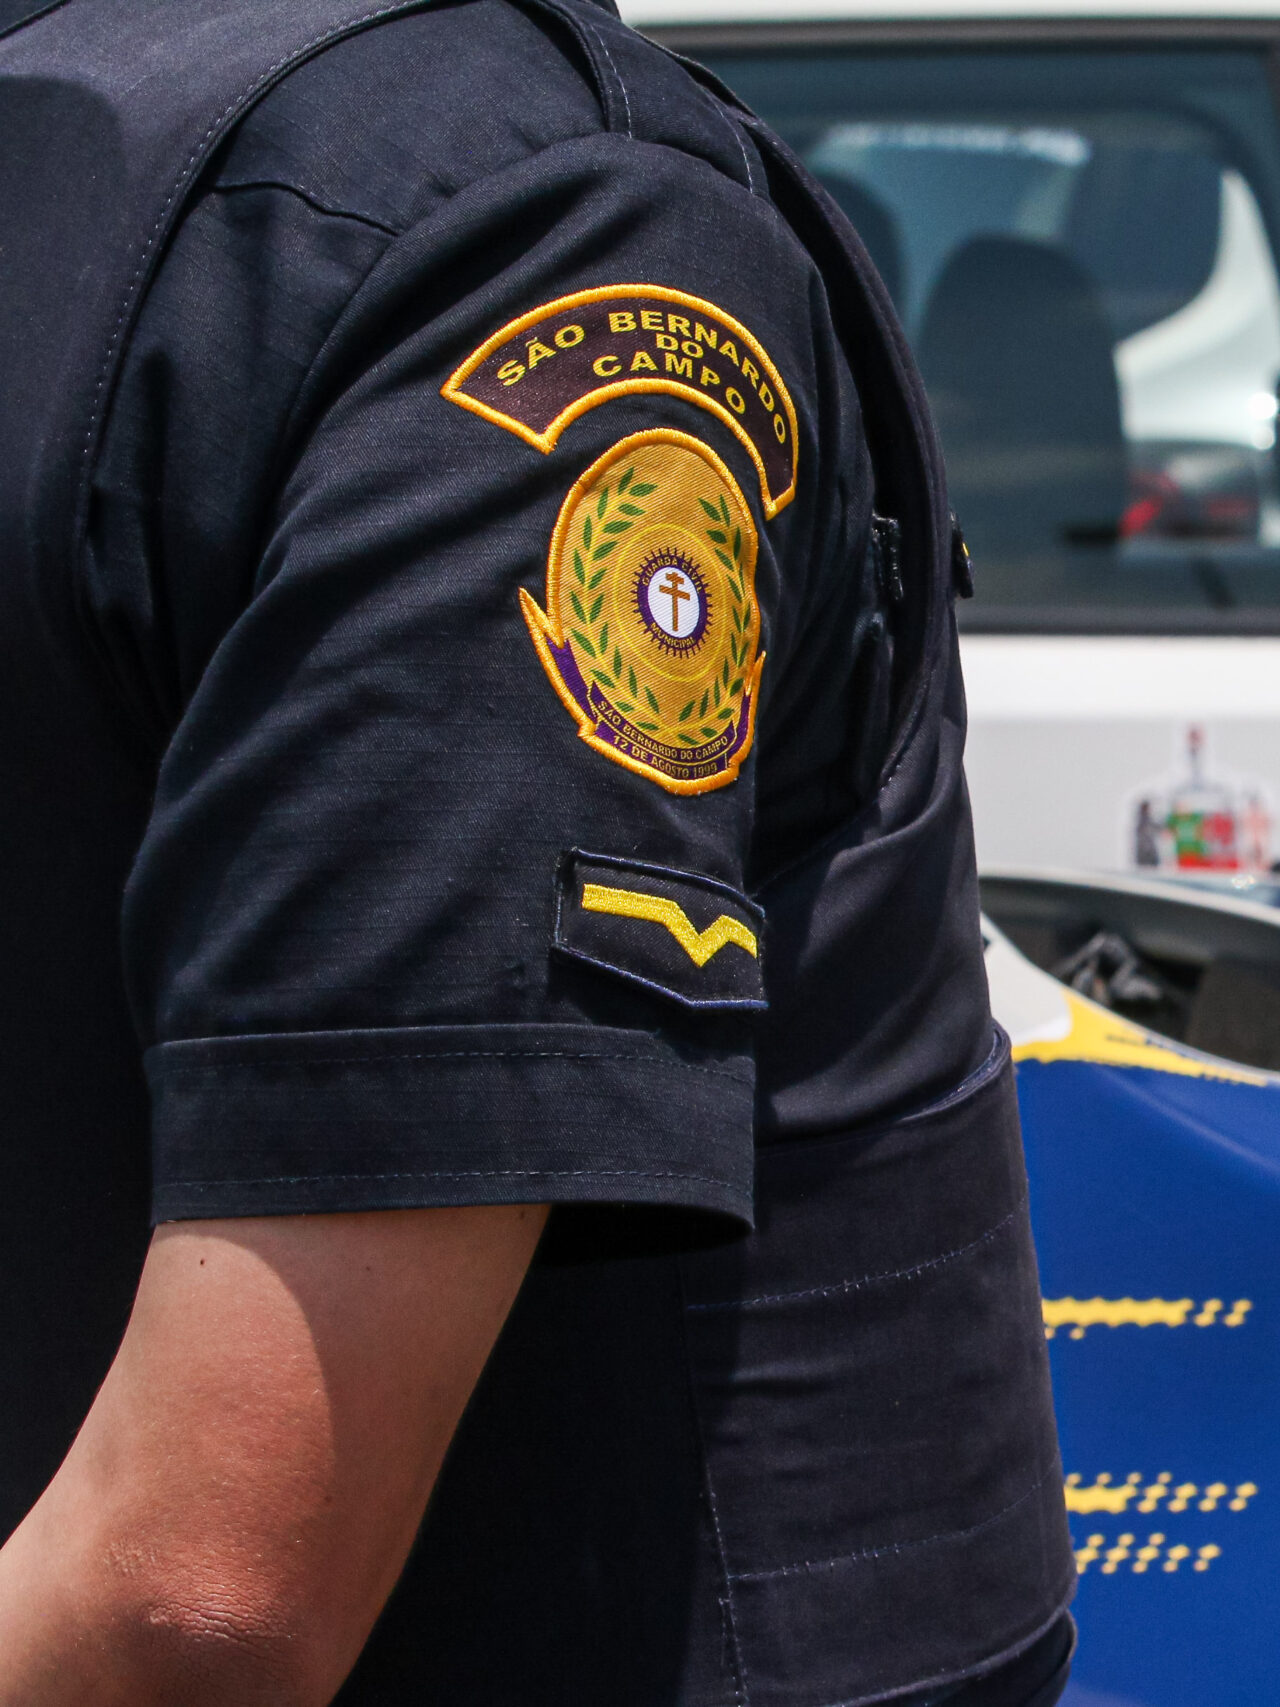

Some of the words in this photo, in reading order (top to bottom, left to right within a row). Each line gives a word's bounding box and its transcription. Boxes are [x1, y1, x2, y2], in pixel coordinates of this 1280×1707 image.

[656, 333, 704, 359] DO
[497, 324, 585, 387] SÃO
[608, 310, 785, 444] BERNARDO
[592, 351, 746, 415] CAMPO
[613, 735, 629, 750] 12
[631, 745, 648, 761] DE
[651, 756, 690, 778] AGOSTO
[623, 724, 677, 759] BERNARDO
[680, 750, 693, 760] DO
[695, 736, 728, 760] CAMPO
